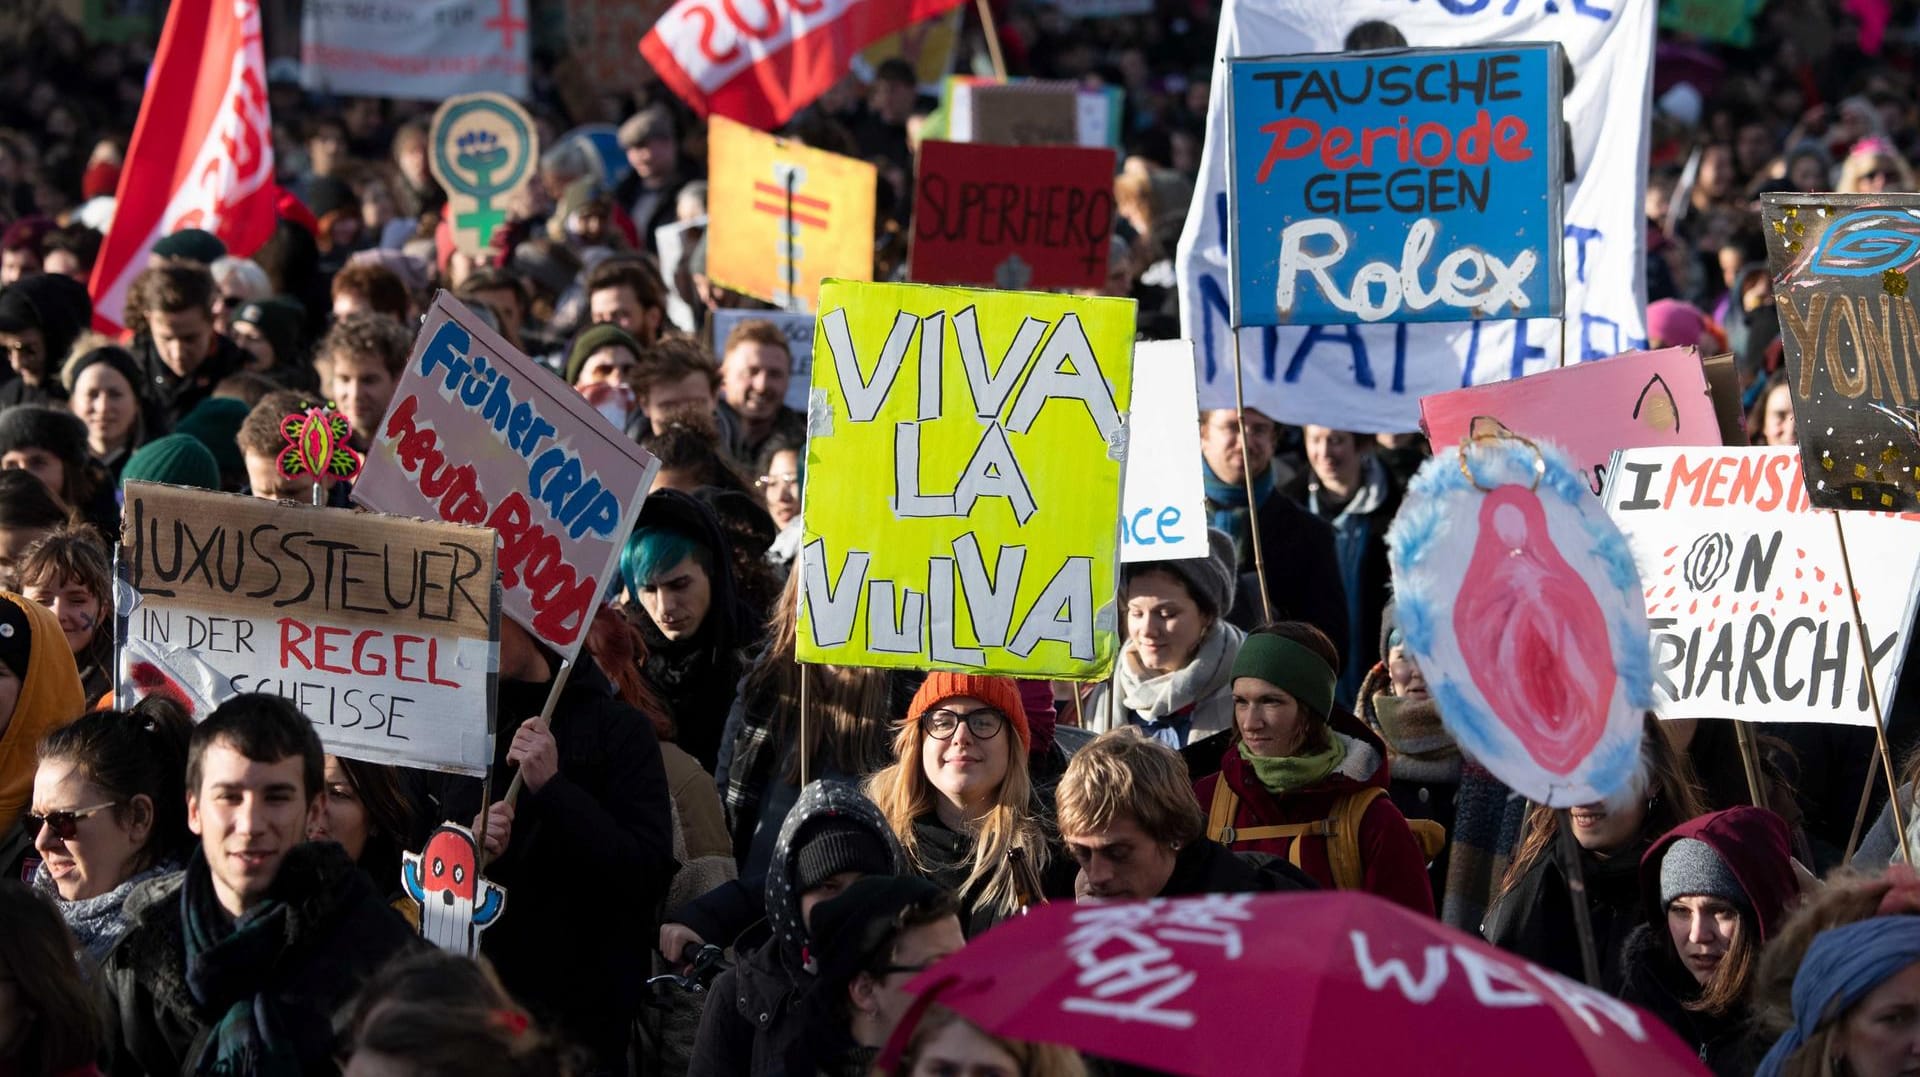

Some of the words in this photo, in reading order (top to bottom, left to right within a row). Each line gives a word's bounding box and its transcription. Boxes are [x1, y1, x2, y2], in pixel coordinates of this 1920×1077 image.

[1253, 55, 1521, 113] TAUSCHE
[1256, 109, 1532, 184] Periode
[1304, 168, 1490, 215] GEGEN
[1277, 218, 1537, 321] Rolex
[821, 304, 1123, 442] VIVA
[421, 320, 556, 457] Früher
[529, 448, 619, 539] CRIP
[889, 420, 1038, 527] LA
[1619, 462, 1662, 510] I
[135, 498, 488, 624] LUXUSSTEUER
[803, 532, 1096, 666] VULVA
[143, 607, 170, 643] IN
[186, 615, 255, 653] DER
[277, 617, 461, 689] REGEL
